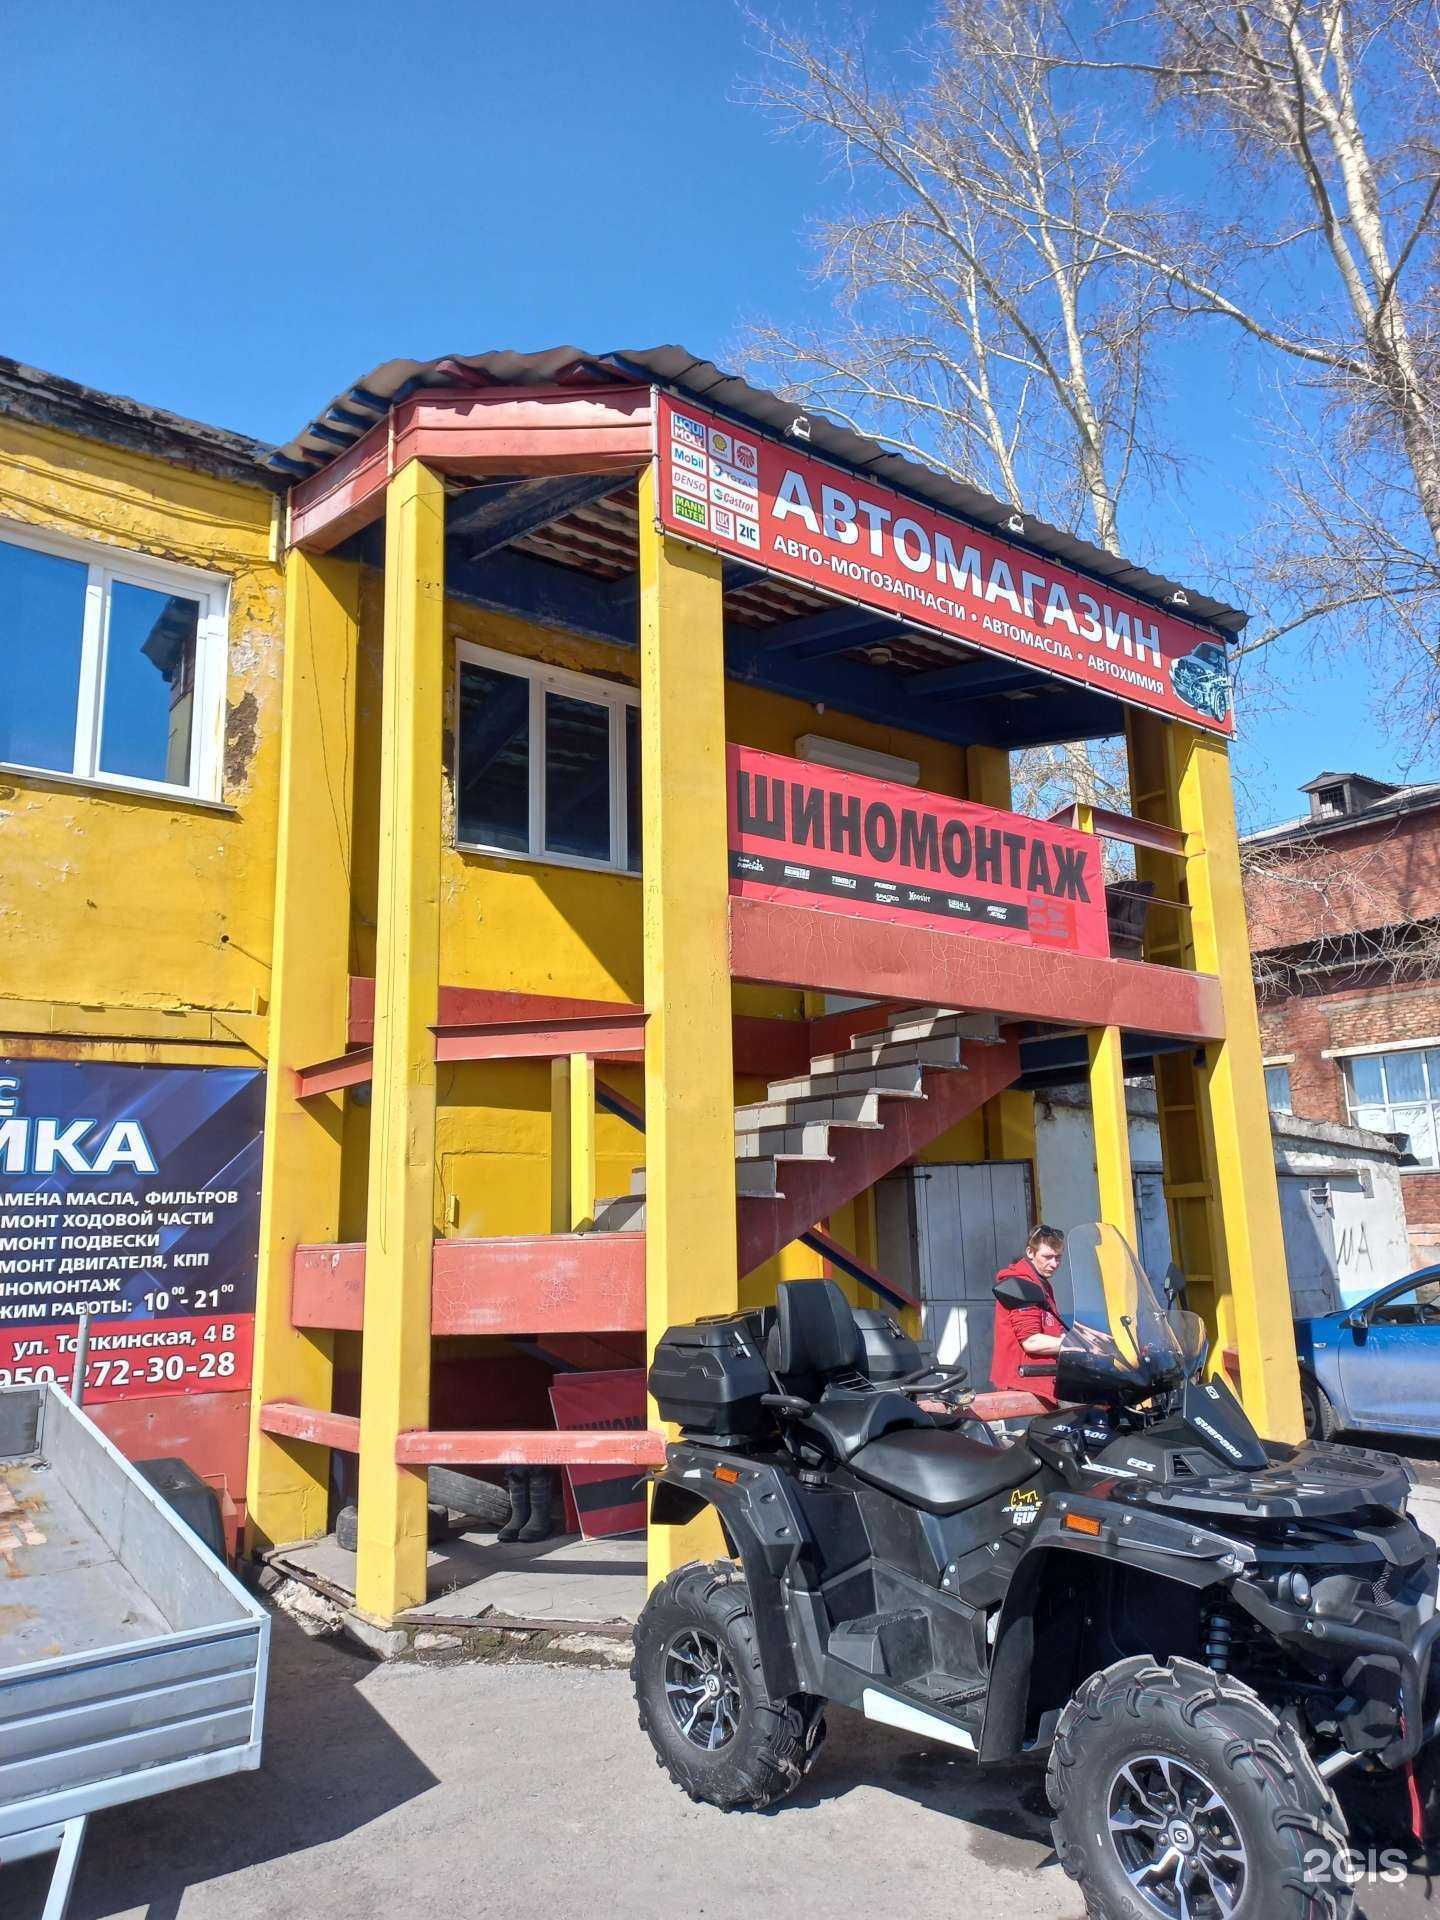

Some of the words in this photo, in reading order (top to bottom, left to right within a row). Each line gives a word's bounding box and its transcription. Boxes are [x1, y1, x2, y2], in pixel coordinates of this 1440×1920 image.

[673, 414, 704, 437] LIQUI
[674, 426, 704, 447] MOLY
[674, 448, 704, 470] Mobil
[674, 472, 705, 492] DENSO
[675, 496, 704, 513] MANN
[723, 493, 754, 513] Castrol
[676, 507, 705, 524] FILTER
[740, 524, 757, 541] ZIC
[771, 469, 1163, 669] АВТОМАГАЗИН
[773, 534, 966, 621] АВТО-МОТОЗАПЧАСТИ
[982, 614, 1073, 661] АВТОМАСЛА
[1087, 655, 1165, 695] АВТОХИМИЯ
[737, 769, 1091, 904] ШИНОМОНТАЖ
[0, 1193, 61, 1206] МЕНА
[66, 1191, 140, 1207] МАСЛА,
[145, 1190, 239, 1206] ФИЛЬТРОВ
[62, 1209, 153, 1230] ХОДОВОЙ
[157, 1211, 214, 1226] ЧАСТИ
[61, 1233, 160, 1252] ПОДВЕСКИ
[58, 1255, 168, 1275] ДВИГАТЕЛЯ,
[173, 1252, 209, 1268] КПП
[12, 1340, 49, 1362] ул.
[203, 1325, 217, 1342] 4
[1126, 1457, 1157, 1472] EPS
